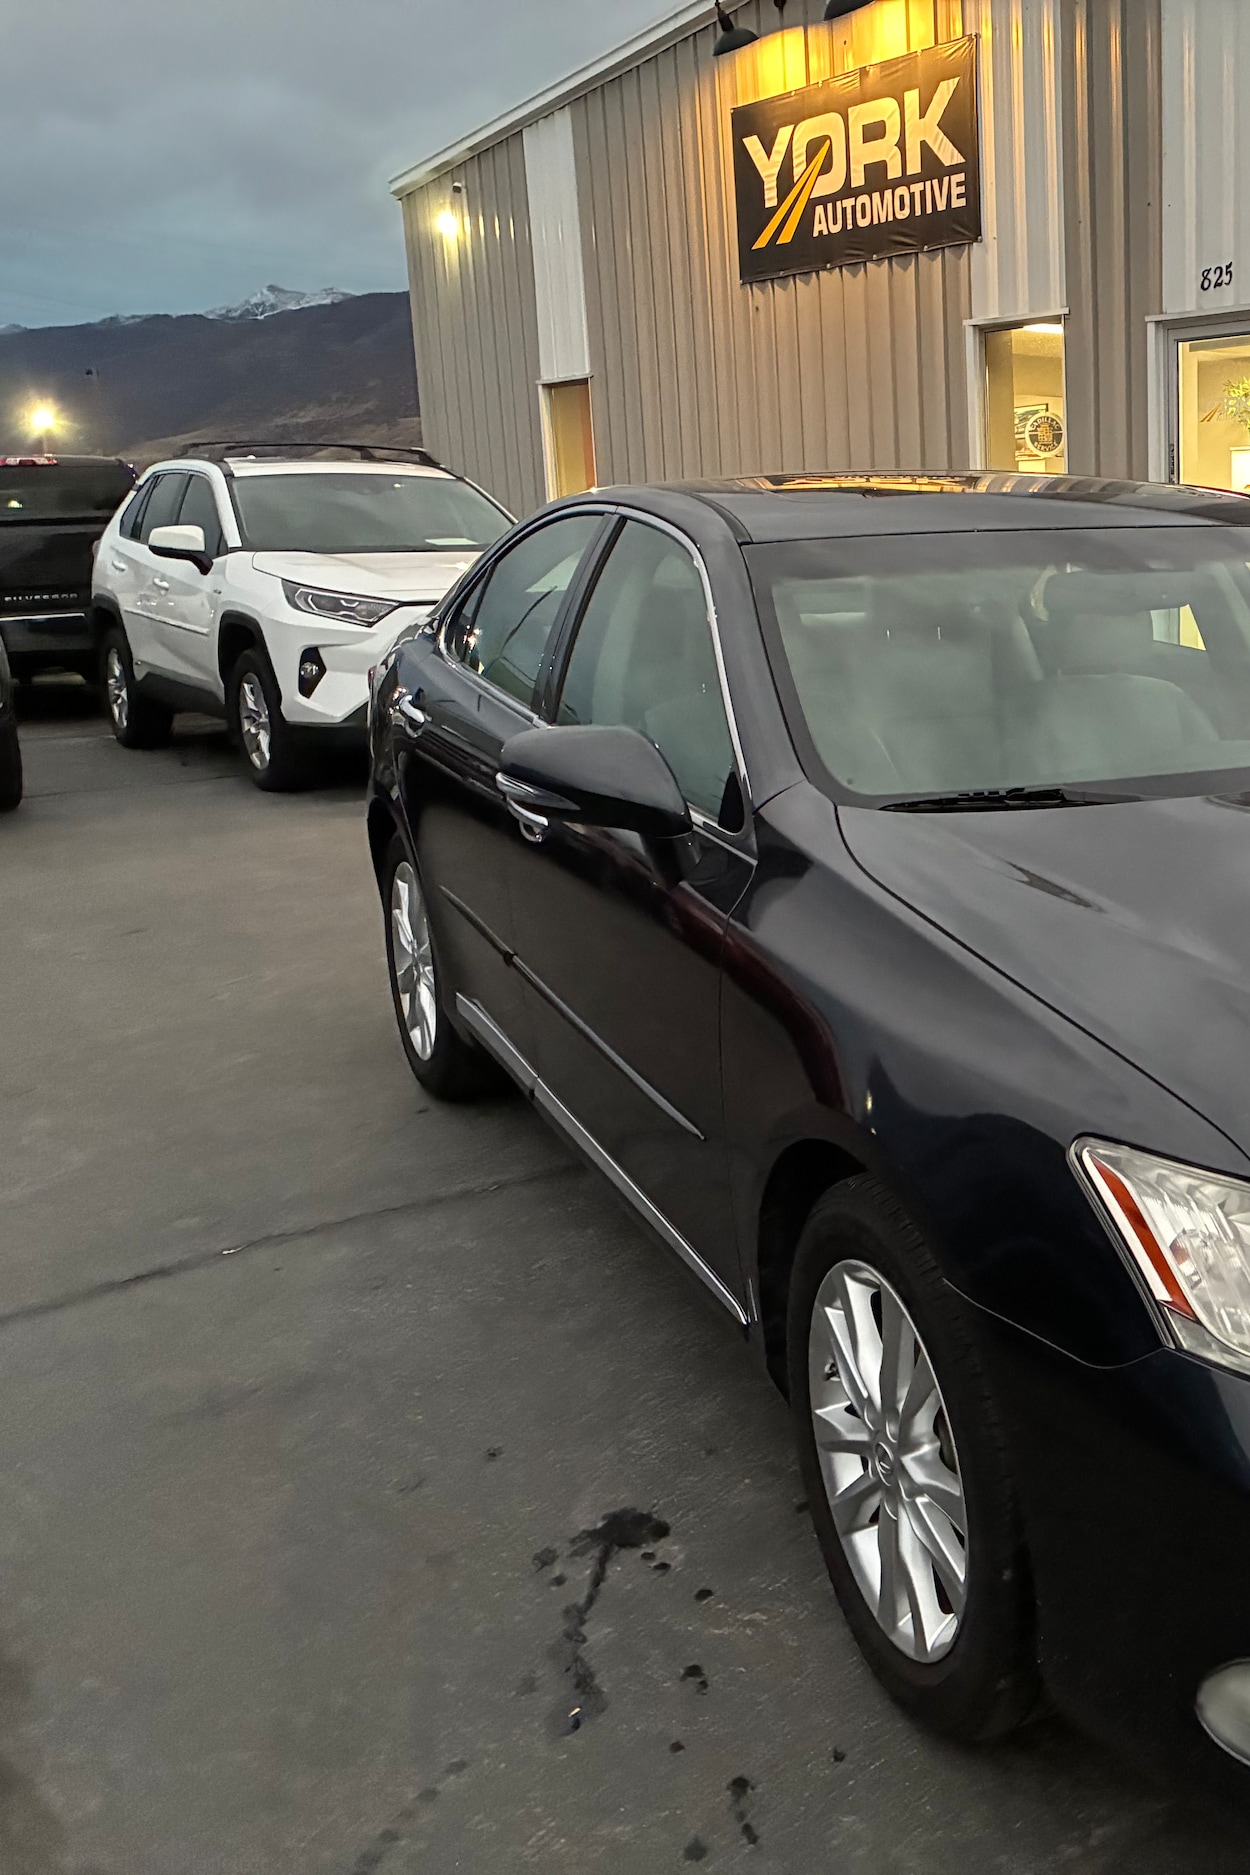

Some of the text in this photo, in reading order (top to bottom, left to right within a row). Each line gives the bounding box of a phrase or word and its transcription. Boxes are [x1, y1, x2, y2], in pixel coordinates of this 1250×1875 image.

[742, 76, 966, 208] YORK
[812, 172, 967, 238] AUTOMOTIVE
[1200, 261, 1233, 291] 825
